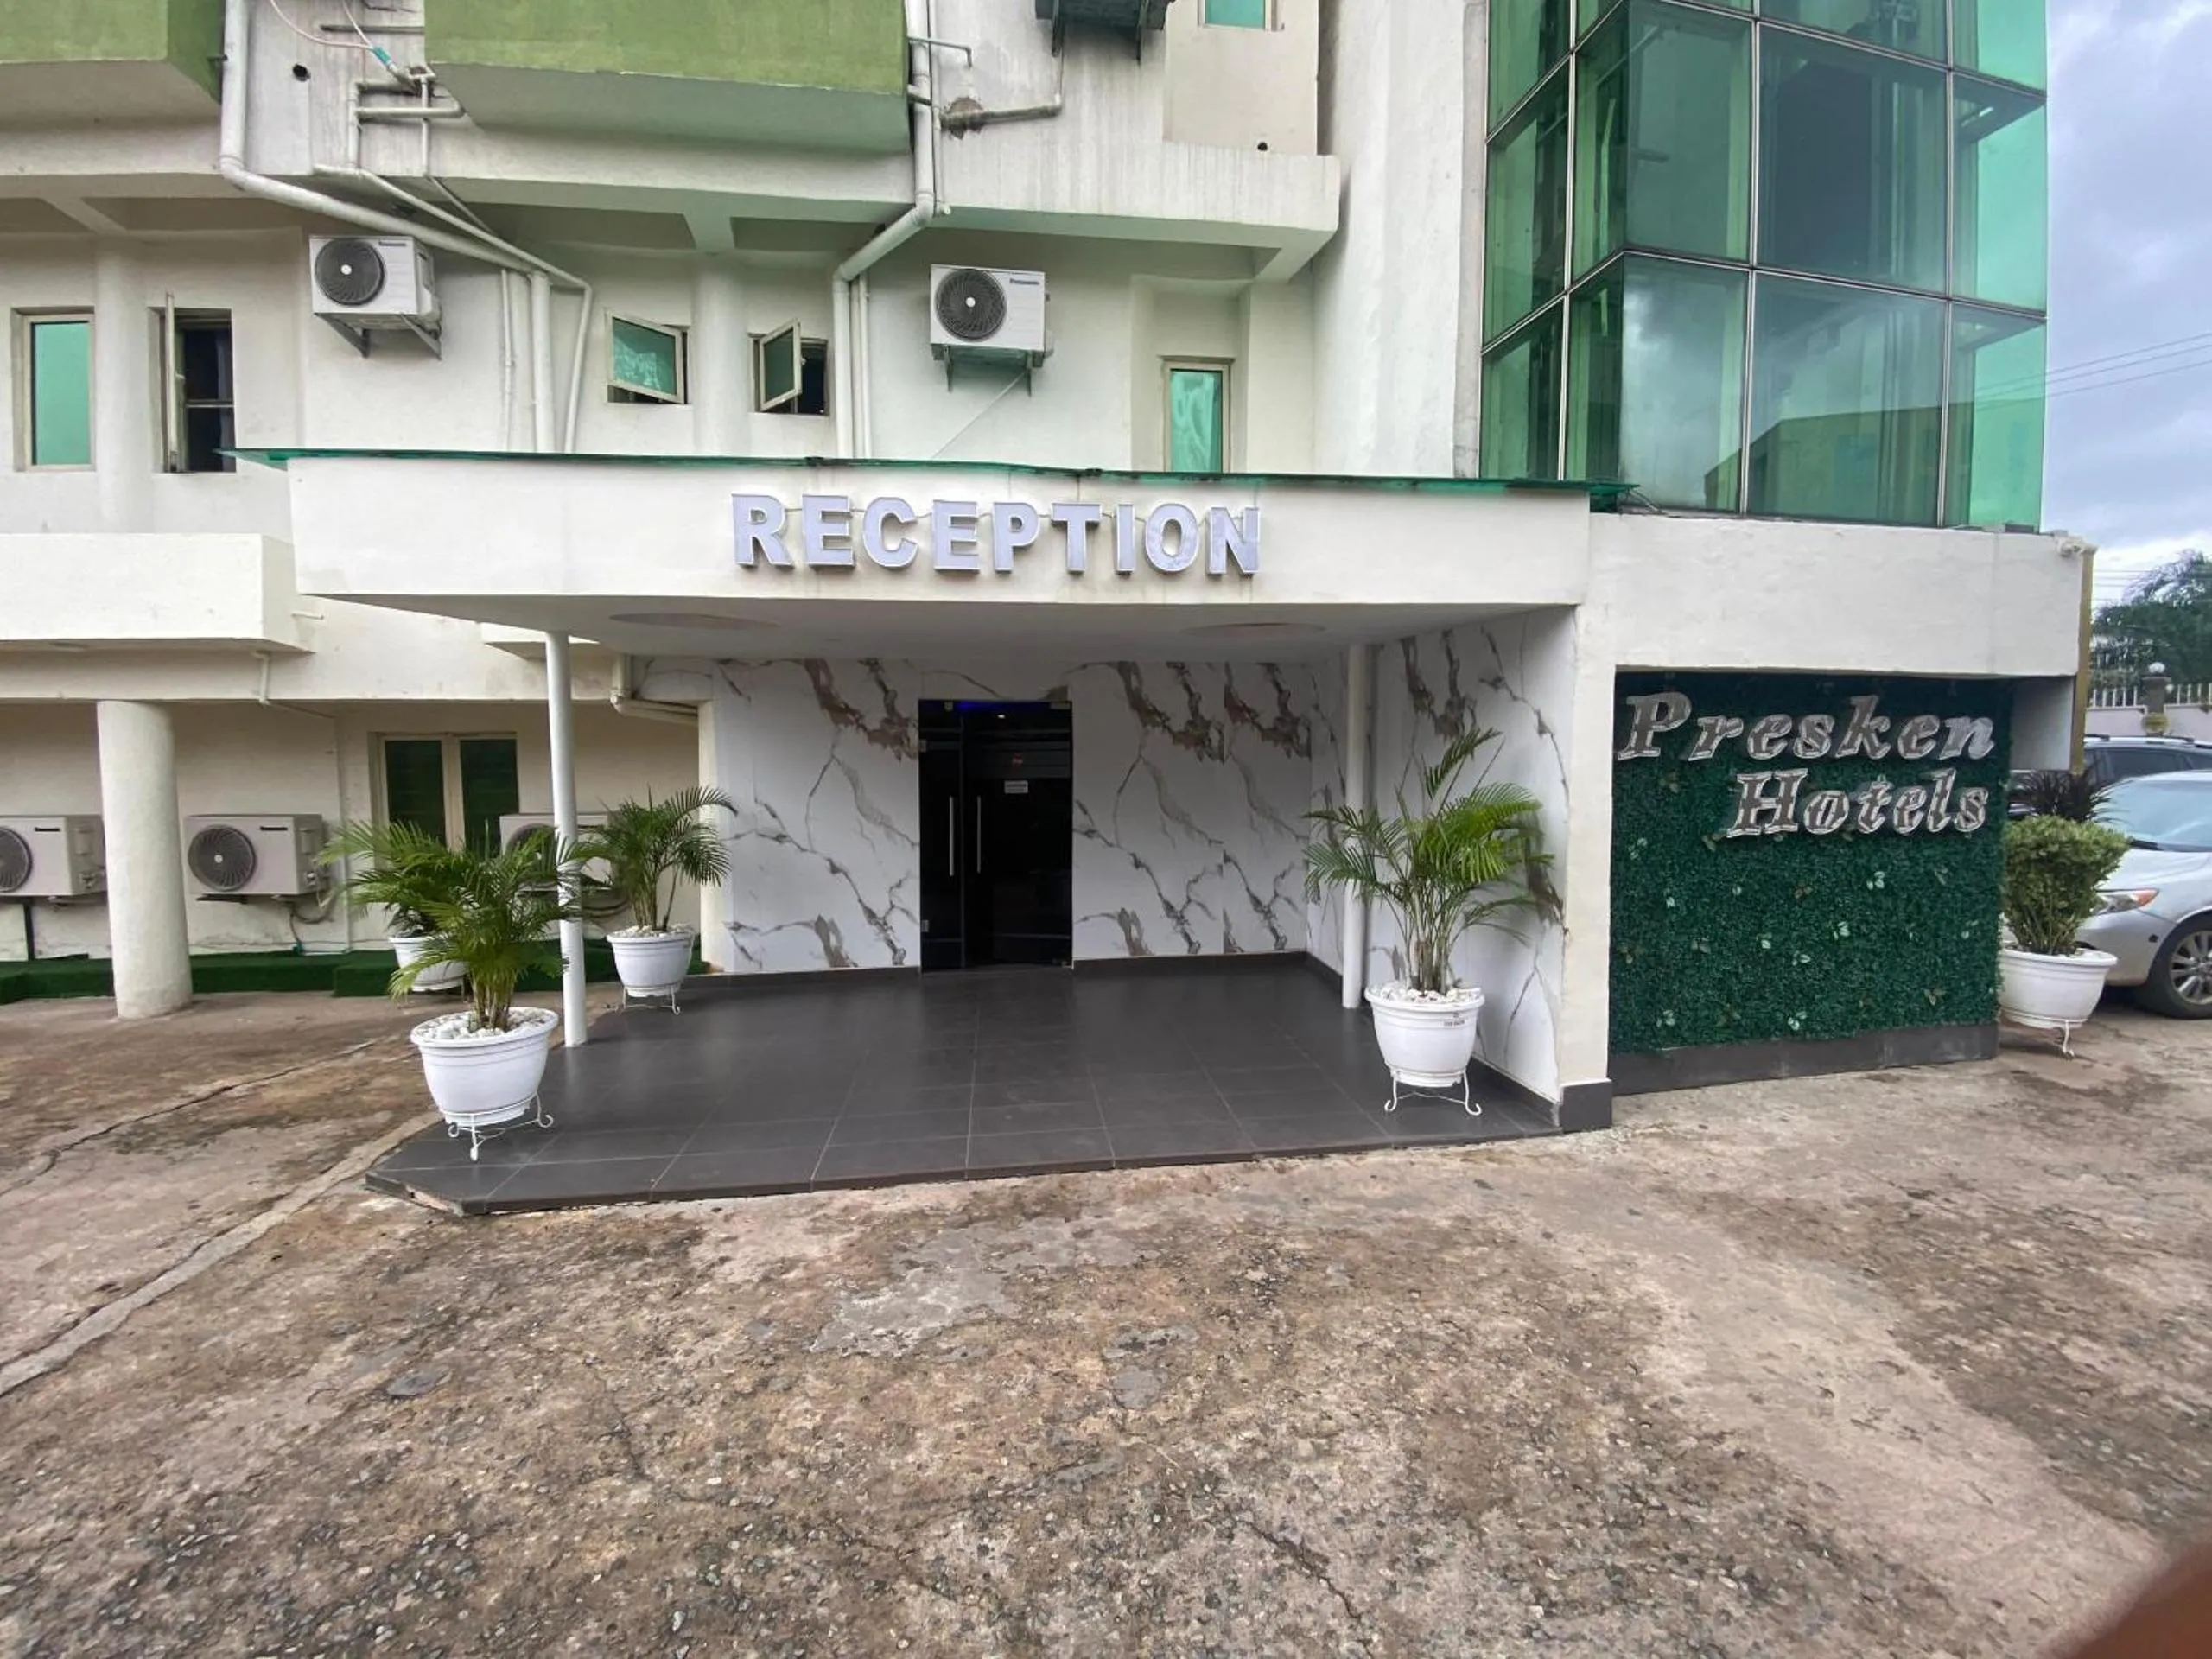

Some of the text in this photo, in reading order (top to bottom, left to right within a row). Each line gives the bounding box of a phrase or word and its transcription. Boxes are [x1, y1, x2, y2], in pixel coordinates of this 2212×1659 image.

[731, 493, 1260, 578] RECEPTION
[1617, 691, 1995, 761] Presken
[1726, 767, 1989, 839] Hotels
